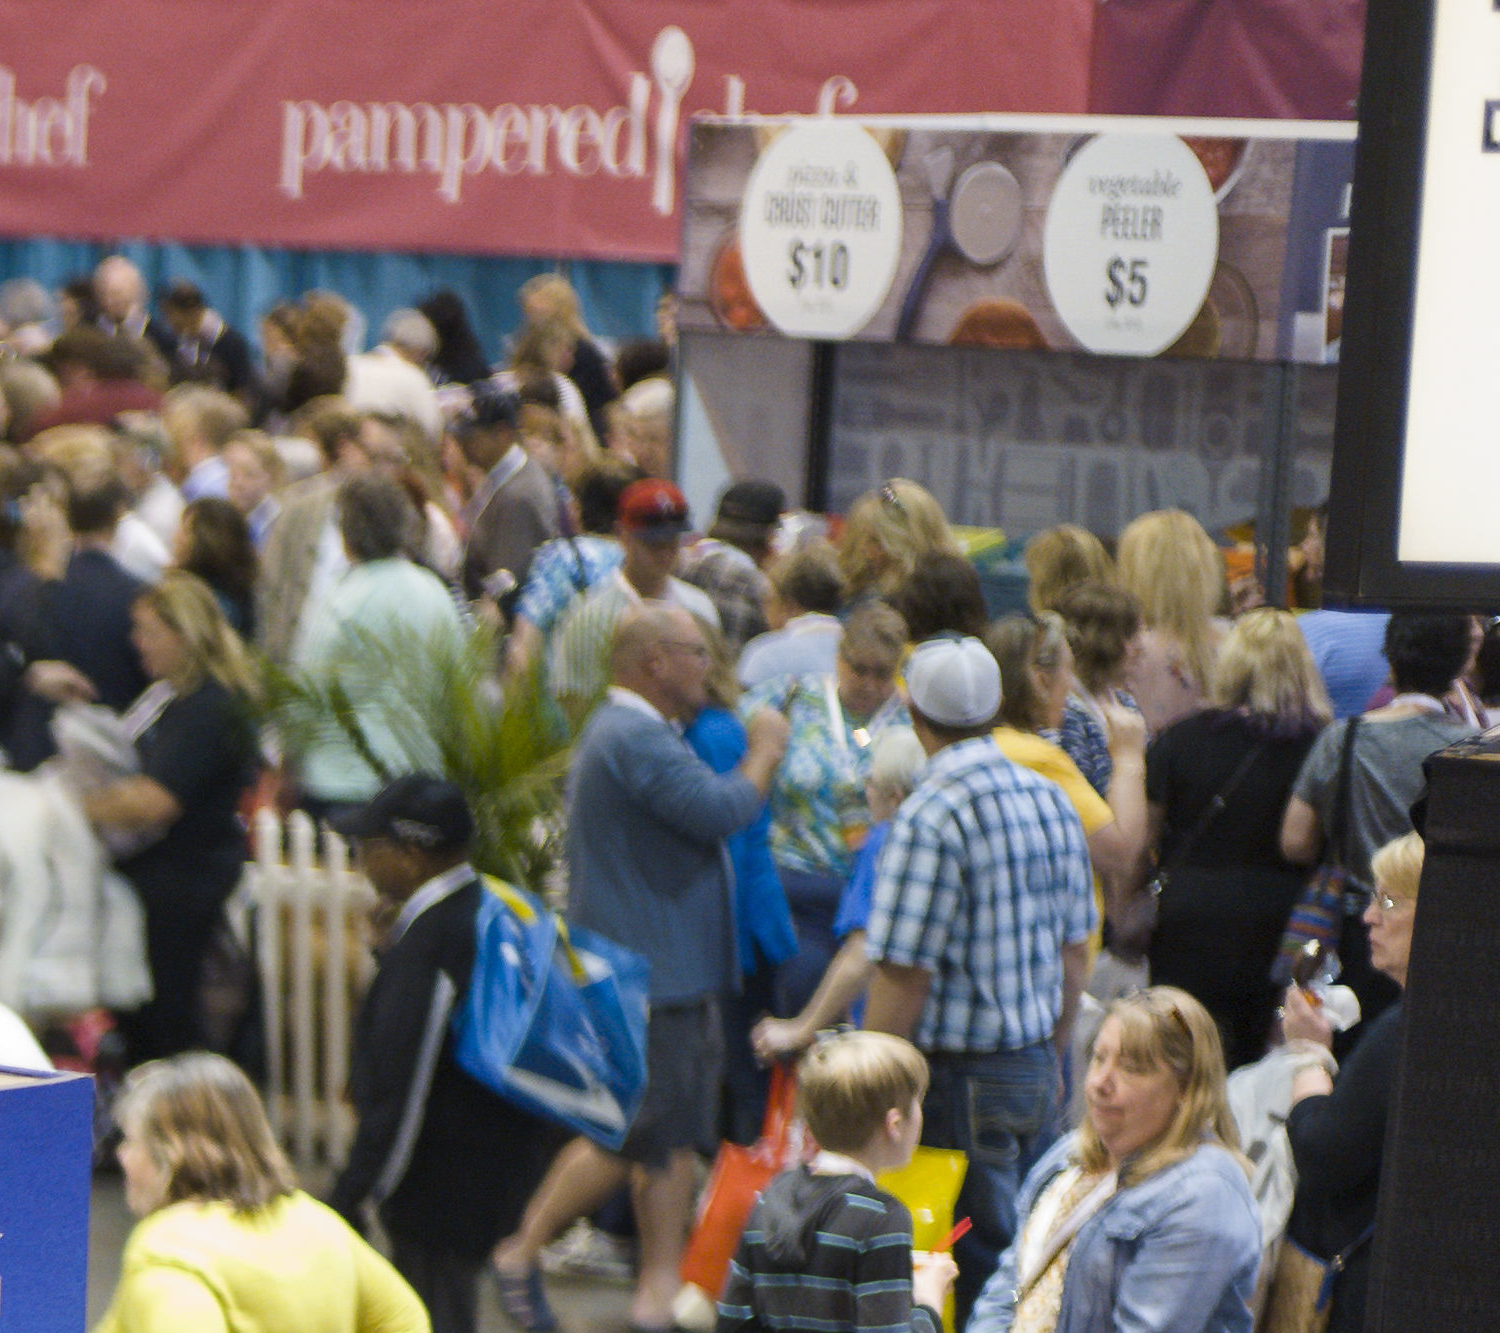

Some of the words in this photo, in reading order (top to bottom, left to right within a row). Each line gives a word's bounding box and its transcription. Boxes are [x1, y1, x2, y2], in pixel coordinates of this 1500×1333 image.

[278, 73, 652, 202] pampered
[1087, 172, 1183, 202] vegetable
[1100, 204, 1164, 241] PEELER
[789, 242, 851, 291] $10
[1104, 256, 1152, 309] $5
